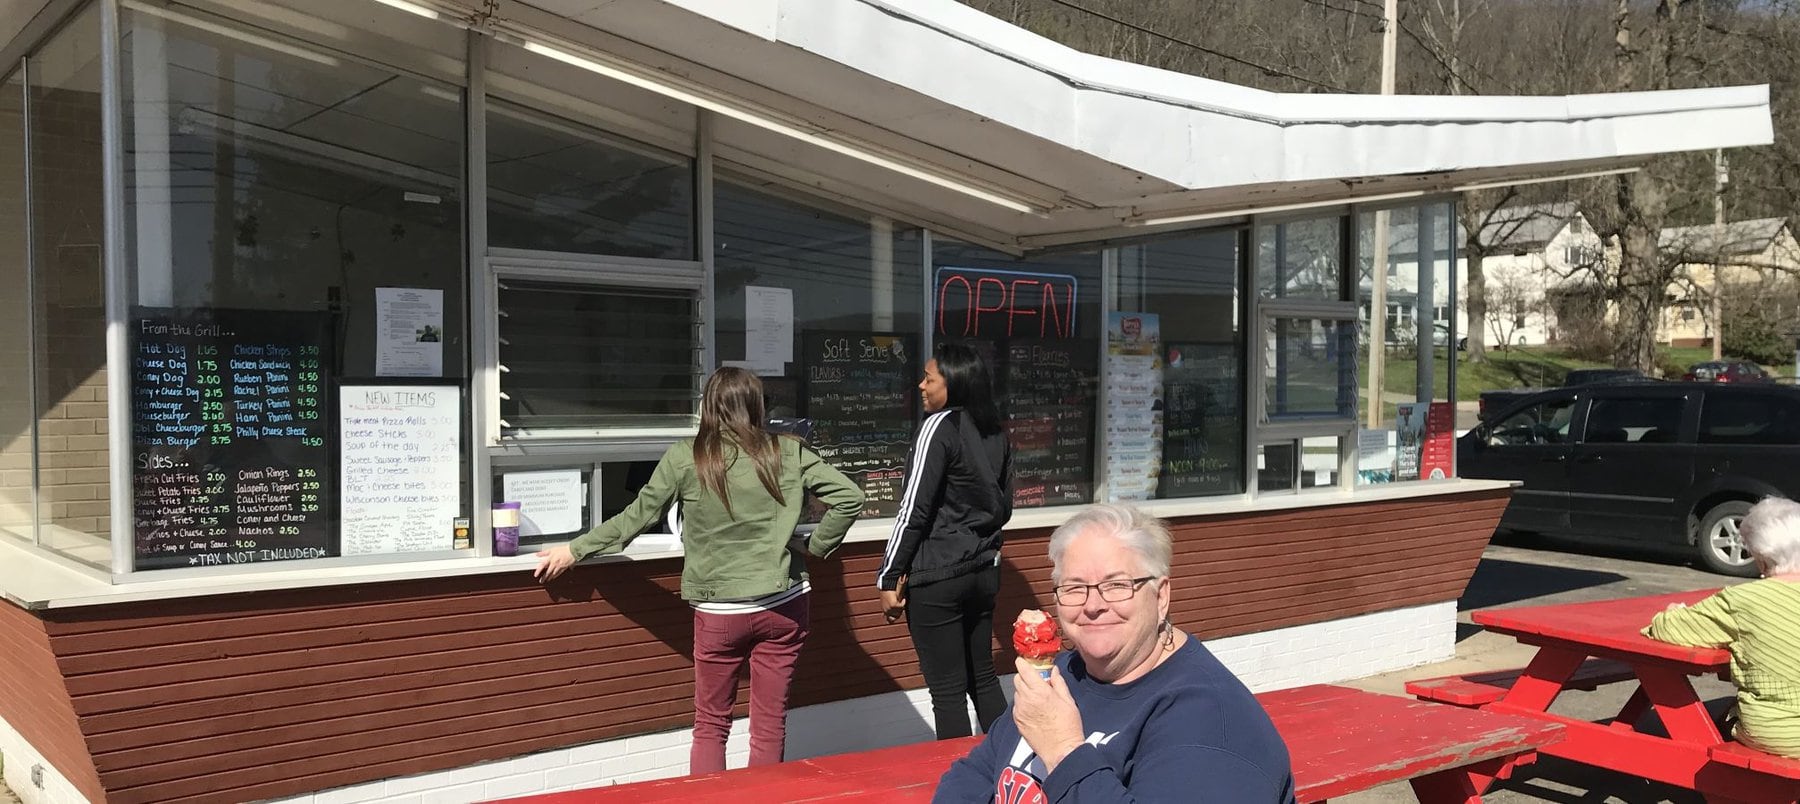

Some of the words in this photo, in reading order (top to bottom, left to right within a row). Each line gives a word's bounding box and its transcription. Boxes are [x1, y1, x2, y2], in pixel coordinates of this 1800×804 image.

[142, 319, 168, 335] From
[169, 323, 191, 336] the
[139, 341, 161, 354] Hot
[166, 343, 186, 360] Dog
[234, 344, 263, 355] Chicken
[266, 344, 291, 358] Strips
[300, 346, 319, 355] 3.50
[823, 338, 850, 358] Soft
[859, 339, 888, 357] Serve
[136, 358, 164, 368] Cheese
[169, 359, 187, 375] Dog
[197, 360, 218, 371] 1.75
[230, 359, 257, 369] Chicken
[258, 359, 291, 369] Sandwich
[137, 372, 160, 384] Coney
[163, 373, 184, 388] Dog
[197, 375, 221, 384] 2.00
[266, 371, 289, 382] Panini
[298, 372, 318, 381] 4.50
[161, 388, 183, 396] Cheese
[186, 388, 199, 402] Dog
[205, 389, 223, 398] 2.15
[234, 385, 259, 396] Rachel
[265, 384, 289, 394] Panini
[298, 385, 318, 393] 4.50
[365, 391, 390, 404] NEW
[395, 391, 436, 406] ITEMS
[136, 401, 183, 414] Hamburger
[203, 402, 223, 411] 2.50
[234, 400, 262, 412] Turkey
[266, 398, 290, 408] Panini
[297, 398, 317, 407] 4.50
[136, 411, 191, 424] Cheeseburger
[235, 412, 259, 422] Ham
[266, 411, 293, 422] Panini
[298, 411, 318, 420] 4.50
[156, 423, 207, 437] Cheeseburger
[212, 423, 232, 433] 3.75
[236, 426, 259, 440] Philly
[262, 426, 283, 436] Cheese
[286, 426, 307, 436] Steak
[136, 436, 163, 445] Pizza
[167, 436, 200, 450] Burger
[211, 436, 231, 445] 3.75
[302, 437, 323, 446] 4.50
[346, 441, 366, 450] Soup
[369, 440, 379, 448] of
[382, 442, 399, 450] the
[403, 442, 419, 452] day
[138, 453, 189, 470] Sides...
[238, 470, 263, 480] Onion
[266, 467, 289, 481] Rings
[297, 469, 316, 478] 2.50
[377, 466, 409, 474] Cheese
[161, 473, 174, 484] Cut
[176, 473, 199, 483] Fries
[207, 473, 226, 482] 2.00
[158, 487, 181, 496] Potato
[182, 486, 202, 495] Fries
[205, 486, 224, 494] 2.00
[271, 482, 300, 493] Poppers
[303, 482, 320, 490] 2.50
[160, 497, 181, 505] Fries
[236, 494, 290, 504] Cauliflower
[301, 494, 318, 502] 2.50
[188, 505, 210, 514] Fries
[212, 505, 230, 513] 2.75
[237, 504, 293, 513] Mushrooms
[301, 504, 319, 512] 2.50
[172, 516, 194, 525] Fries
[200, 517, 219, 525] 4.75
[236, 515, 261, 525] Coney
[263, 514, 279, 522] and
[179, 528, 205, 538] Cheese
[238, 526, 274, 535] Nachos
[279, 526, 300, 535] 2.50
[235, 540, 256, 548] 4.00
[226, 551, 256, 563] NOT
